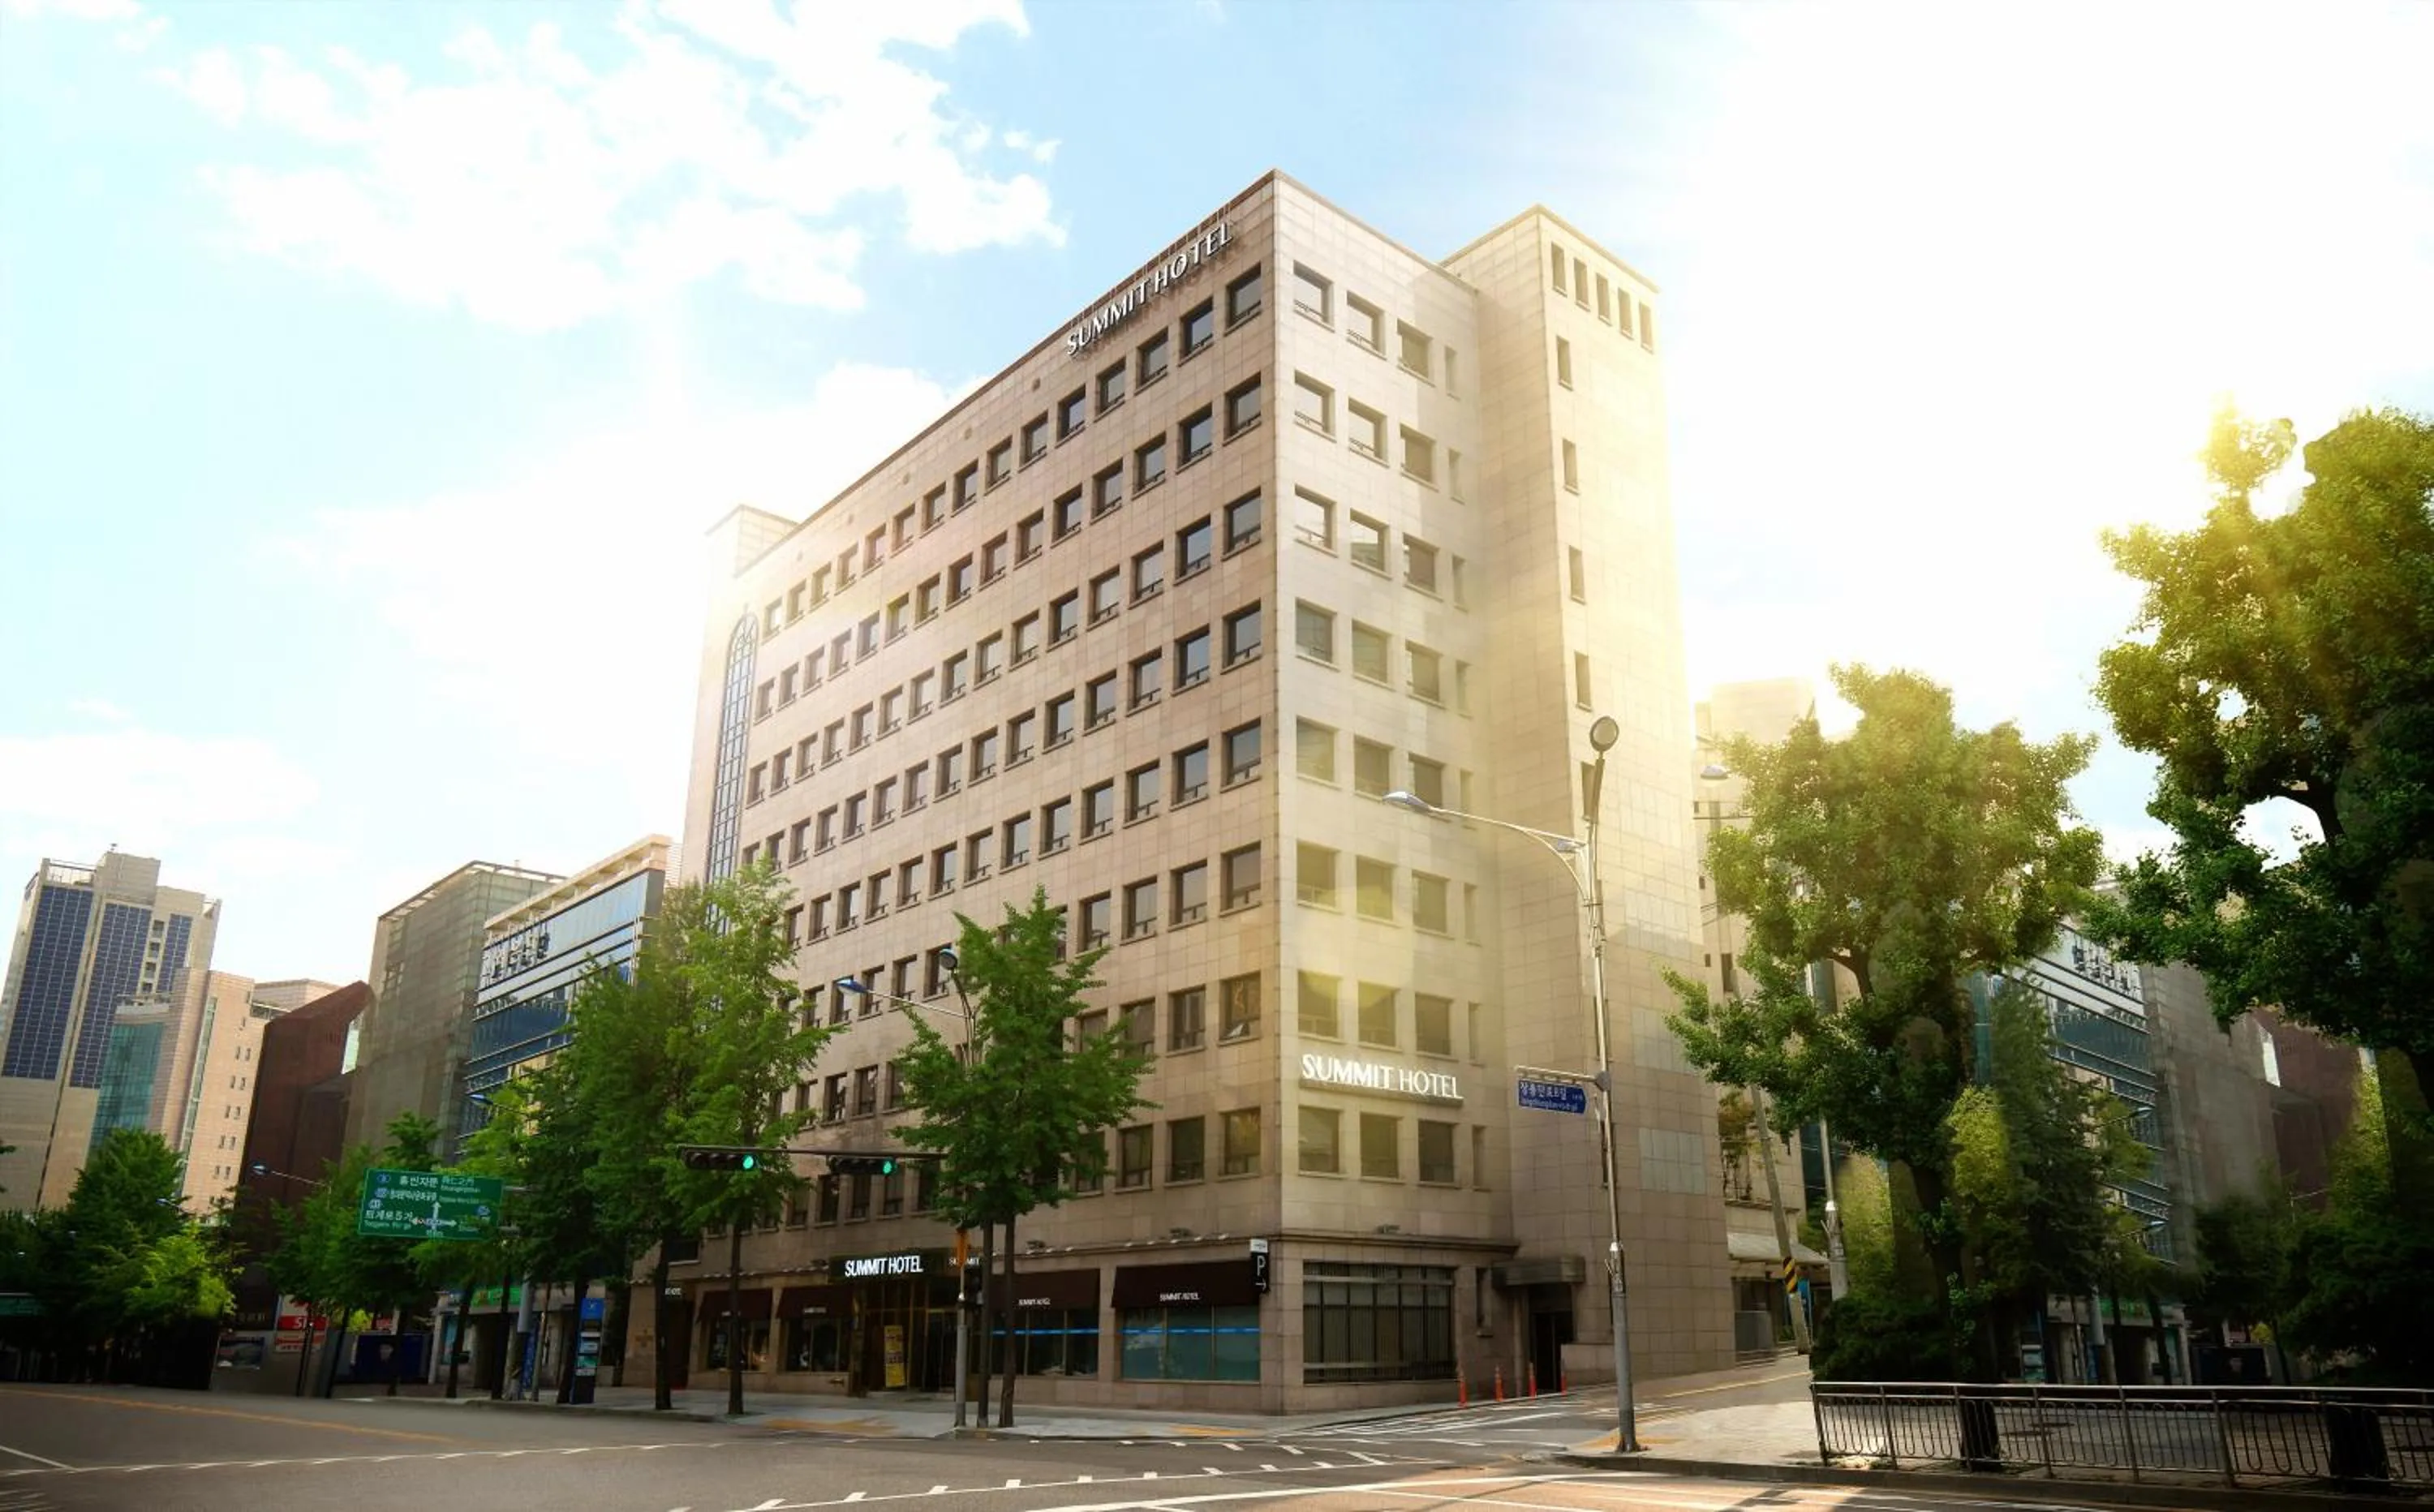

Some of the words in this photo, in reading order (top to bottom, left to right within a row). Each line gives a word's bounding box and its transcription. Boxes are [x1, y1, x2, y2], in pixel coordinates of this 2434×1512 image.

[1065, 277, 1151, 356] SUMMIT
[1154, 221, 1233, 294] HOTEL
[1301, 1054, 1395, 1090] SUMMIT
[1399, 1068, 1464, 1100] HOTEL
[845, 1258, 888, 1278] SUMMIT
[888, 1255, 923, 1274] HOTEL
[1257, 1255, 1266, 1276] P
